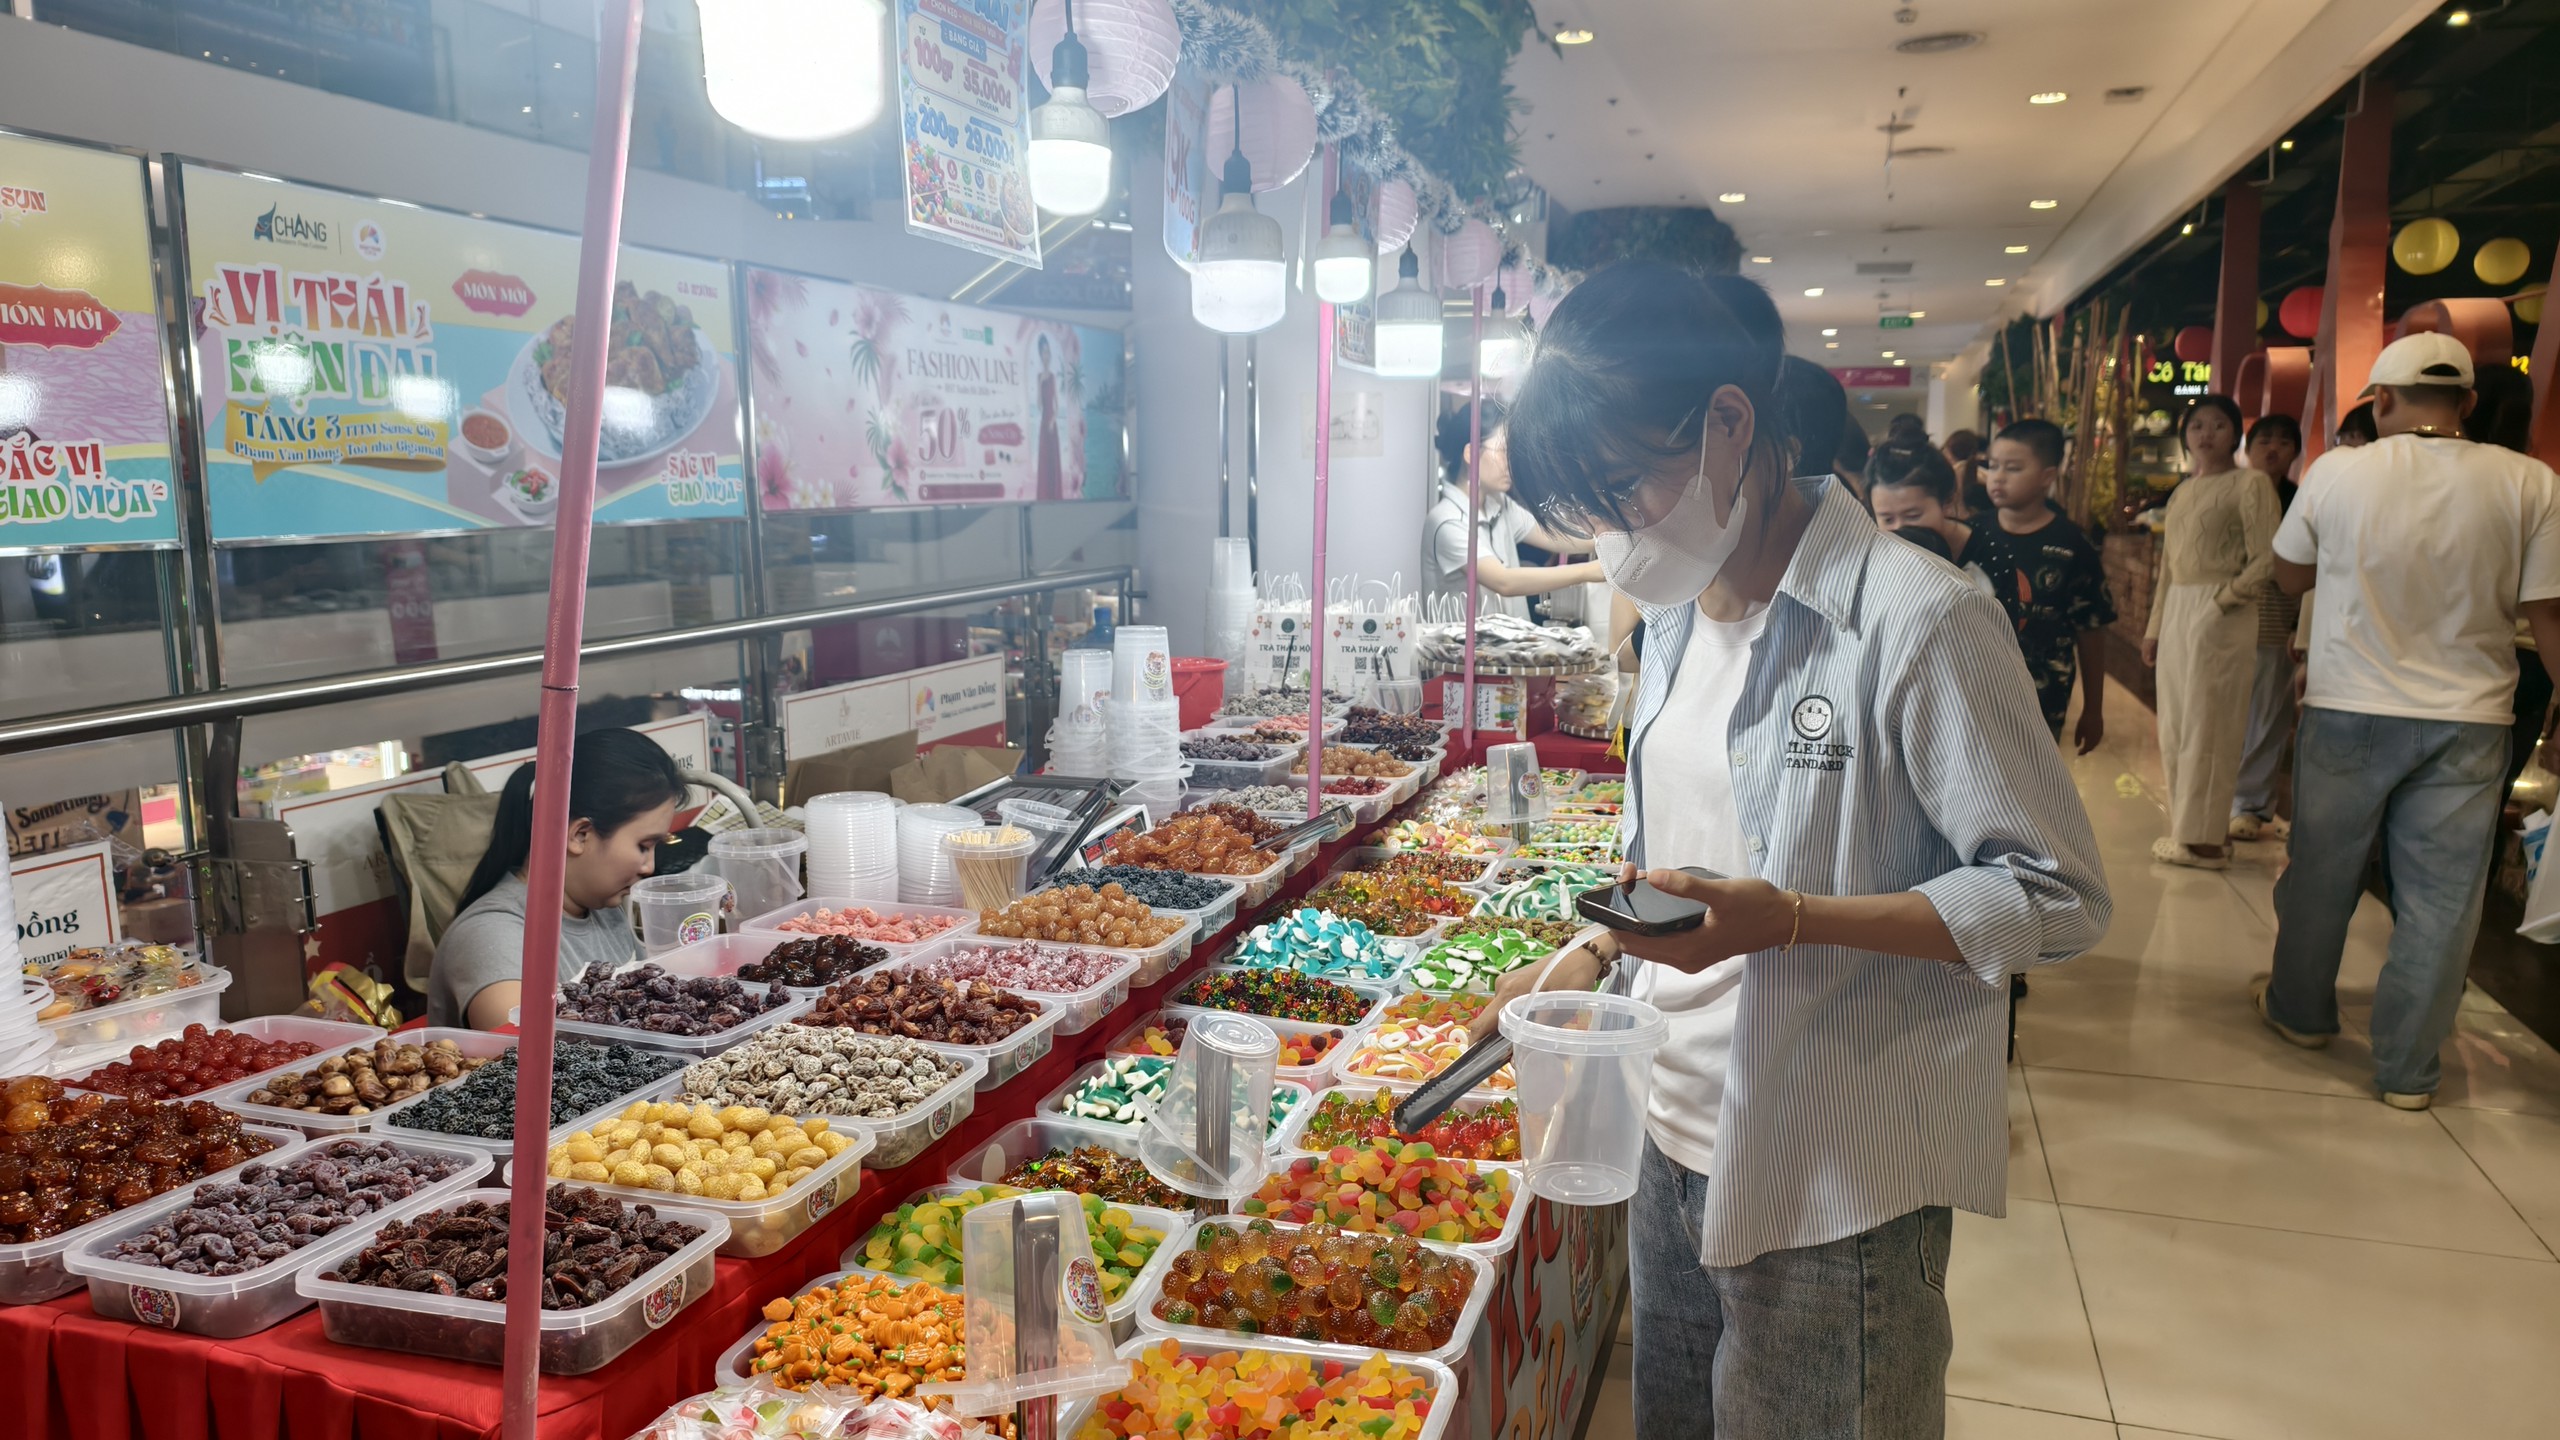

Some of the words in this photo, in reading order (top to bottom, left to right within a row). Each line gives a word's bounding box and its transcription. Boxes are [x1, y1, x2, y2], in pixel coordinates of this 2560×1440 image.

[914, 35, 954, 83] 100gr
[962, 65, 1012, 109] 35.000đ
[918, 103, 959, 148] 200gr
[1, 186, 46, 213] SỤN
[274, 213, 327, 243] CHANG
[221, 268, 281, 336] VỊ
[293, 276, 408, 338] THÁI
[53, 306, 103, 331] MỚI
[227, 330, 347, 408] HN
[906, 348, 981, 383] FASHION
[984, 354, 1020, 386] LINE
[239, 406, 317, 442] TẦNG
[325, 413, 342, 441] 3
[344, 422, 377, 439] TTTM
[380, 422, 414, 436] Sense
[416, 424, 436, 442] City
[918, 406, 972, 462] 50%
[64, 443, 102, 480] VỊ
[234, 440, 275, 462] Phạm
[278, 448, 304, 462] Văn
[371, 442, 394, 453] nhà
[396, 441, 445, 458] Gigamall
[701, 454, 717, 479] VỊ
[75, 482, 153, 518] MÙA
[669, 481, 703, 503] GIAO
[704, 479, 737, 502] MÙA
[1299, 644, 1312, 653] MỘ
[1385, 645, 1399, 655] ỘC
[824, 729, 862, 748] ARTAVIE
[1815, 743, 1855, 759] LUCK
[1785, 757, 1845, 772] TANDARD
[21, 944, 77, 968] igamal
